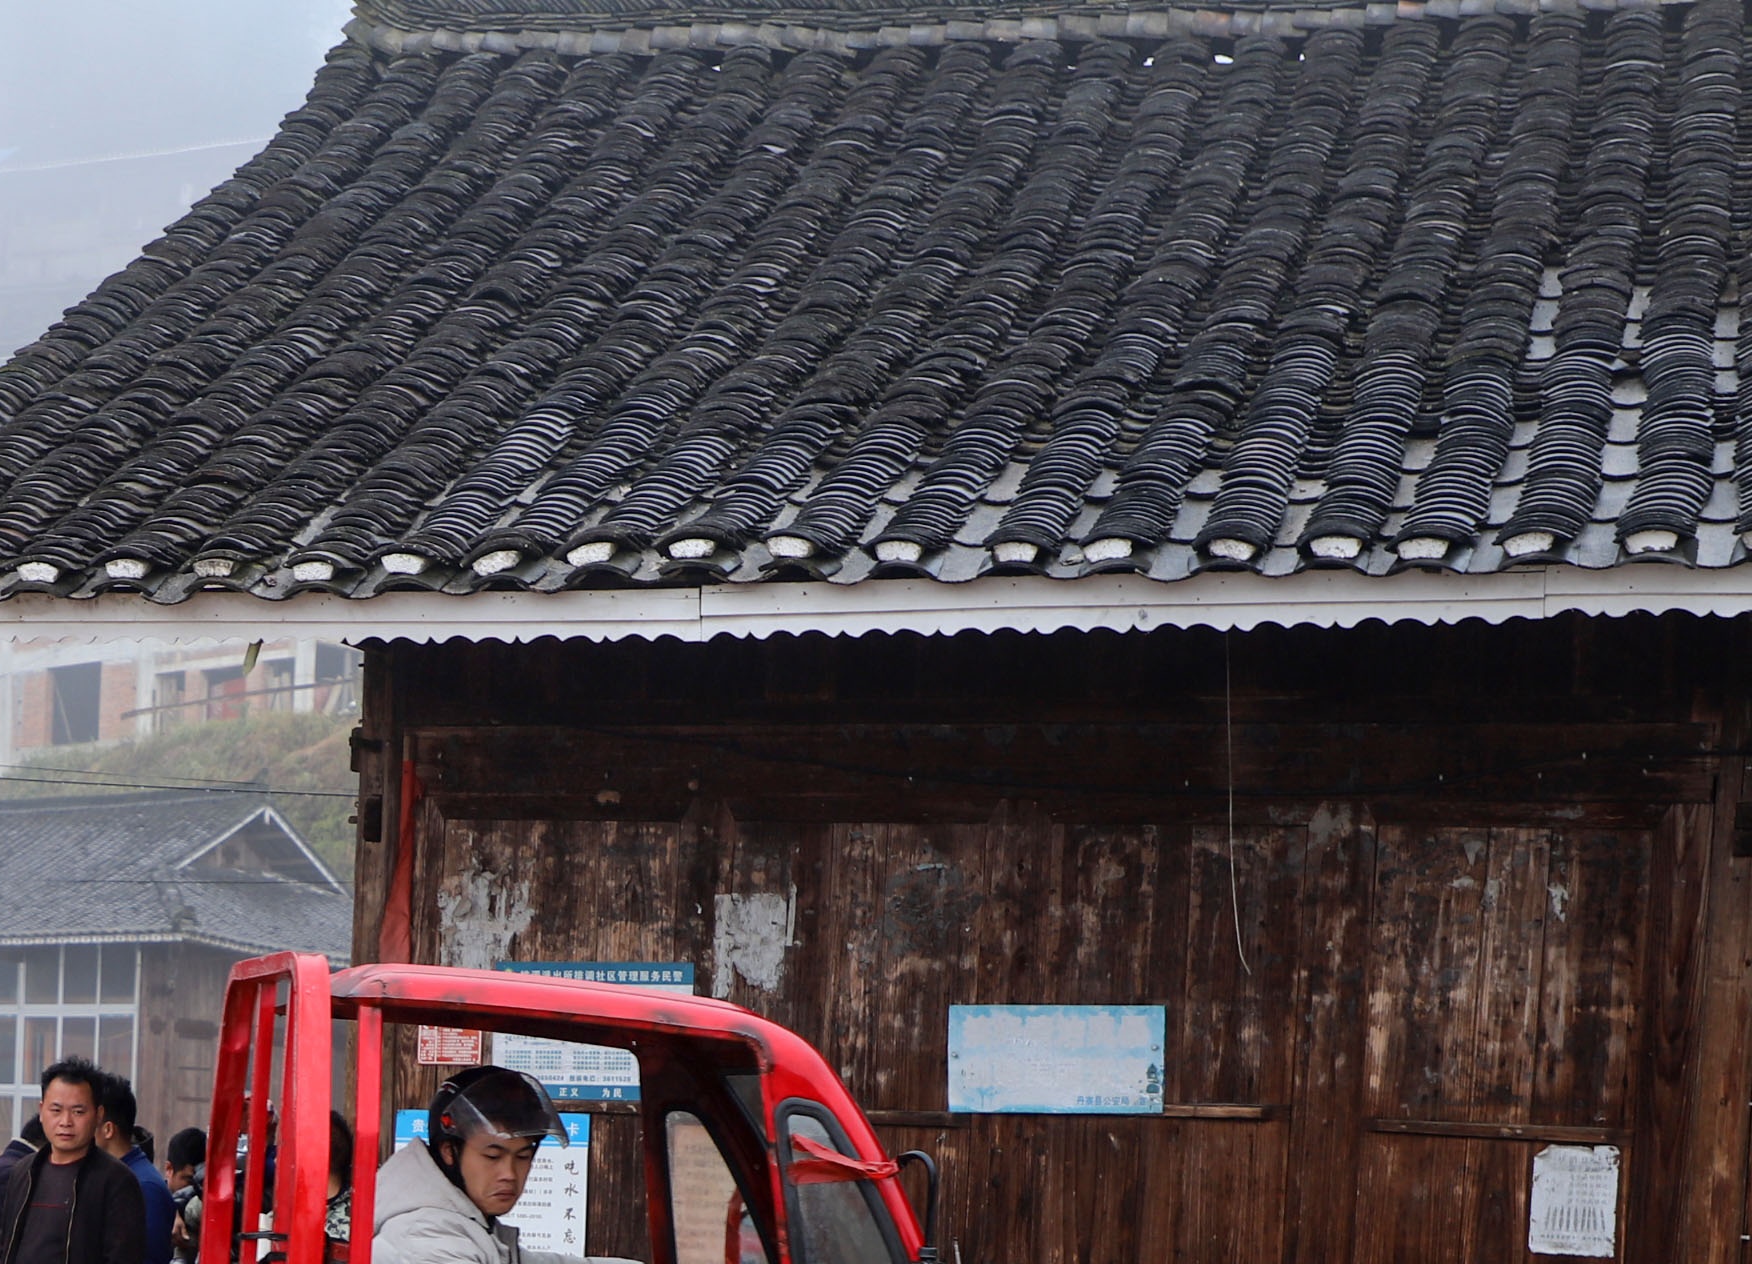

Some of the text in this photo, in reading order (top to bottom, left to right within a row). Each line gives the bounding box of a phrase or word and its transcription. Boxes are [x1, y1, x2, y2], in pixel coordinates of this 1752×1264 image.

[559, 1087, 623, 1098] 正义 为民
[563, 1160, 580, 1256] 吃水不忘
